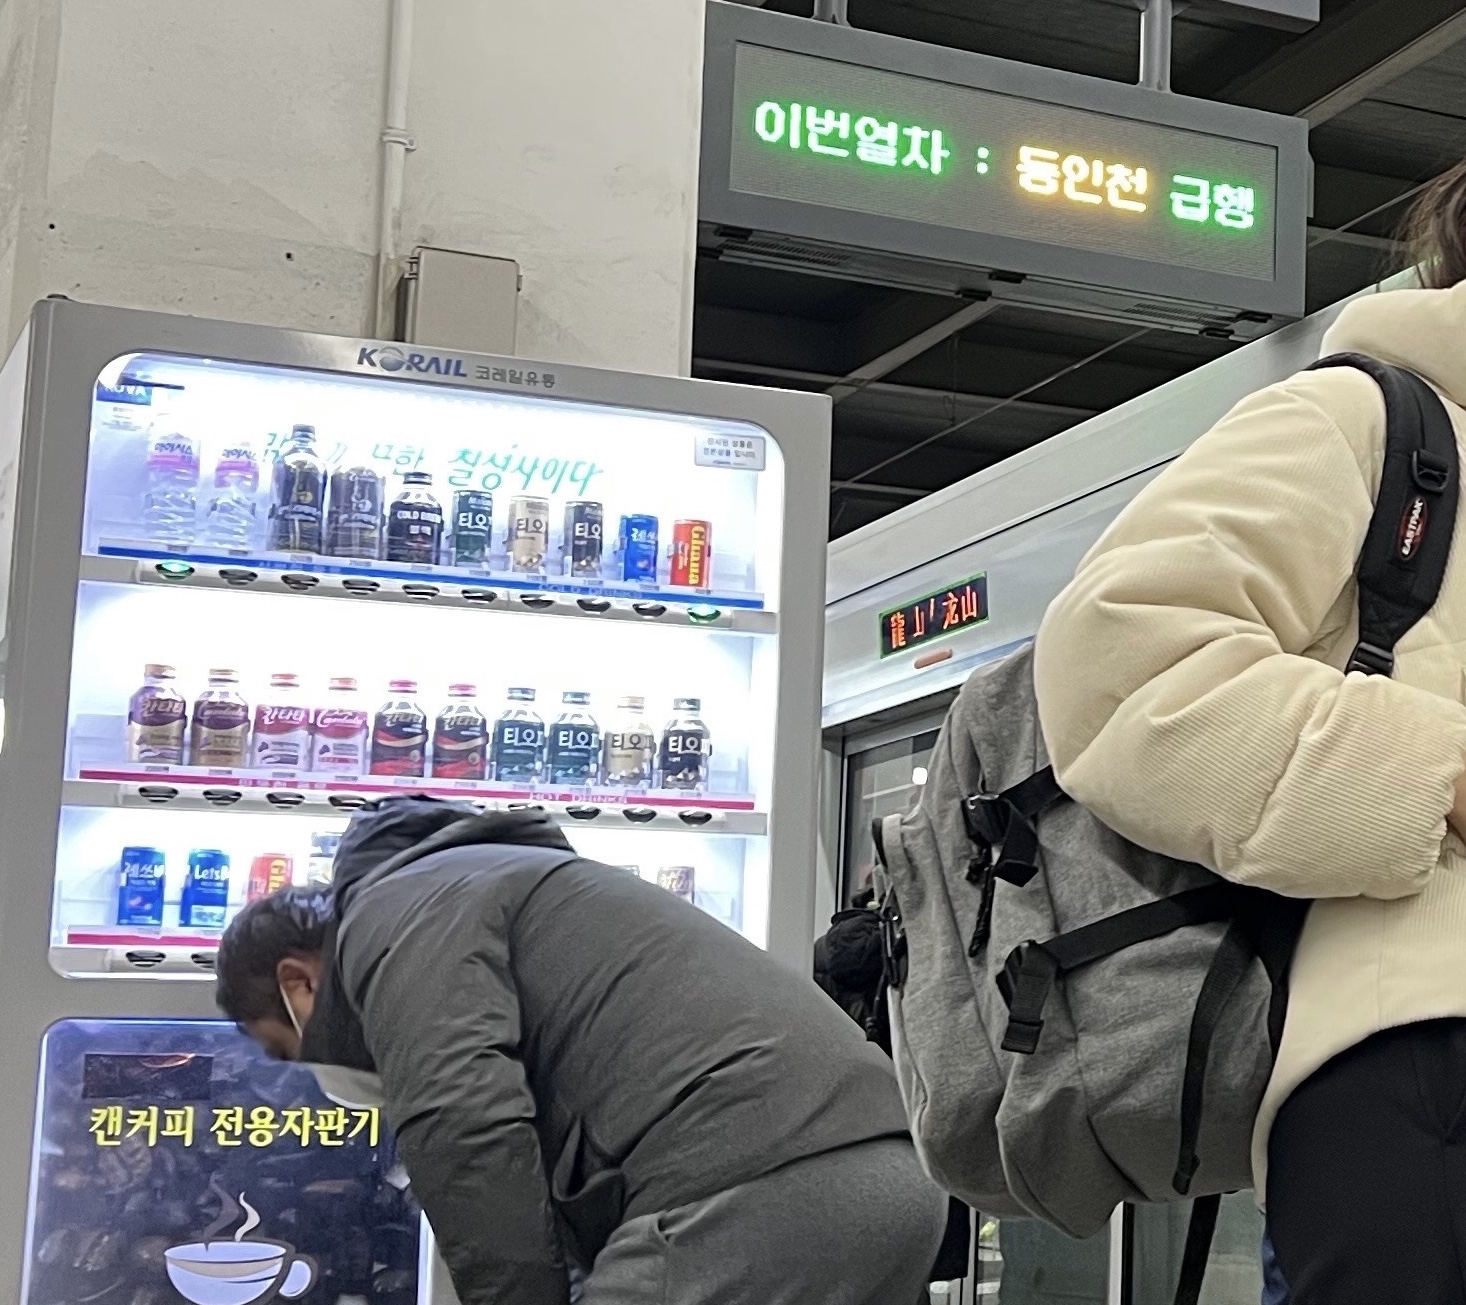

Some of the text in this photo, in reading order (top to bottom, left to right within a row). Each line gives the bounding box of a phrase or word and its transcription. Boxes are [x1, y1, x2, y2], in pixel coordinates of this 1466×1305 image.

[755, 99, 950, 175] 이번열차
[1015, 143, 1149, 213] 동인천
[1169, 173, 1256, 230] 급행
[356, 346, 556, 389] KORAIL 코레일유통
[447, 443, 605, 497] 칠성사이다
[458, 512, 493, 530] 티오
[516, 517, 548, 534] 티오
[575, 521, 602, 540] 티오
[261, 705, 307, 725] 칸타타
[88, 1105, 381, 1148] 캔커피 전용자판기
